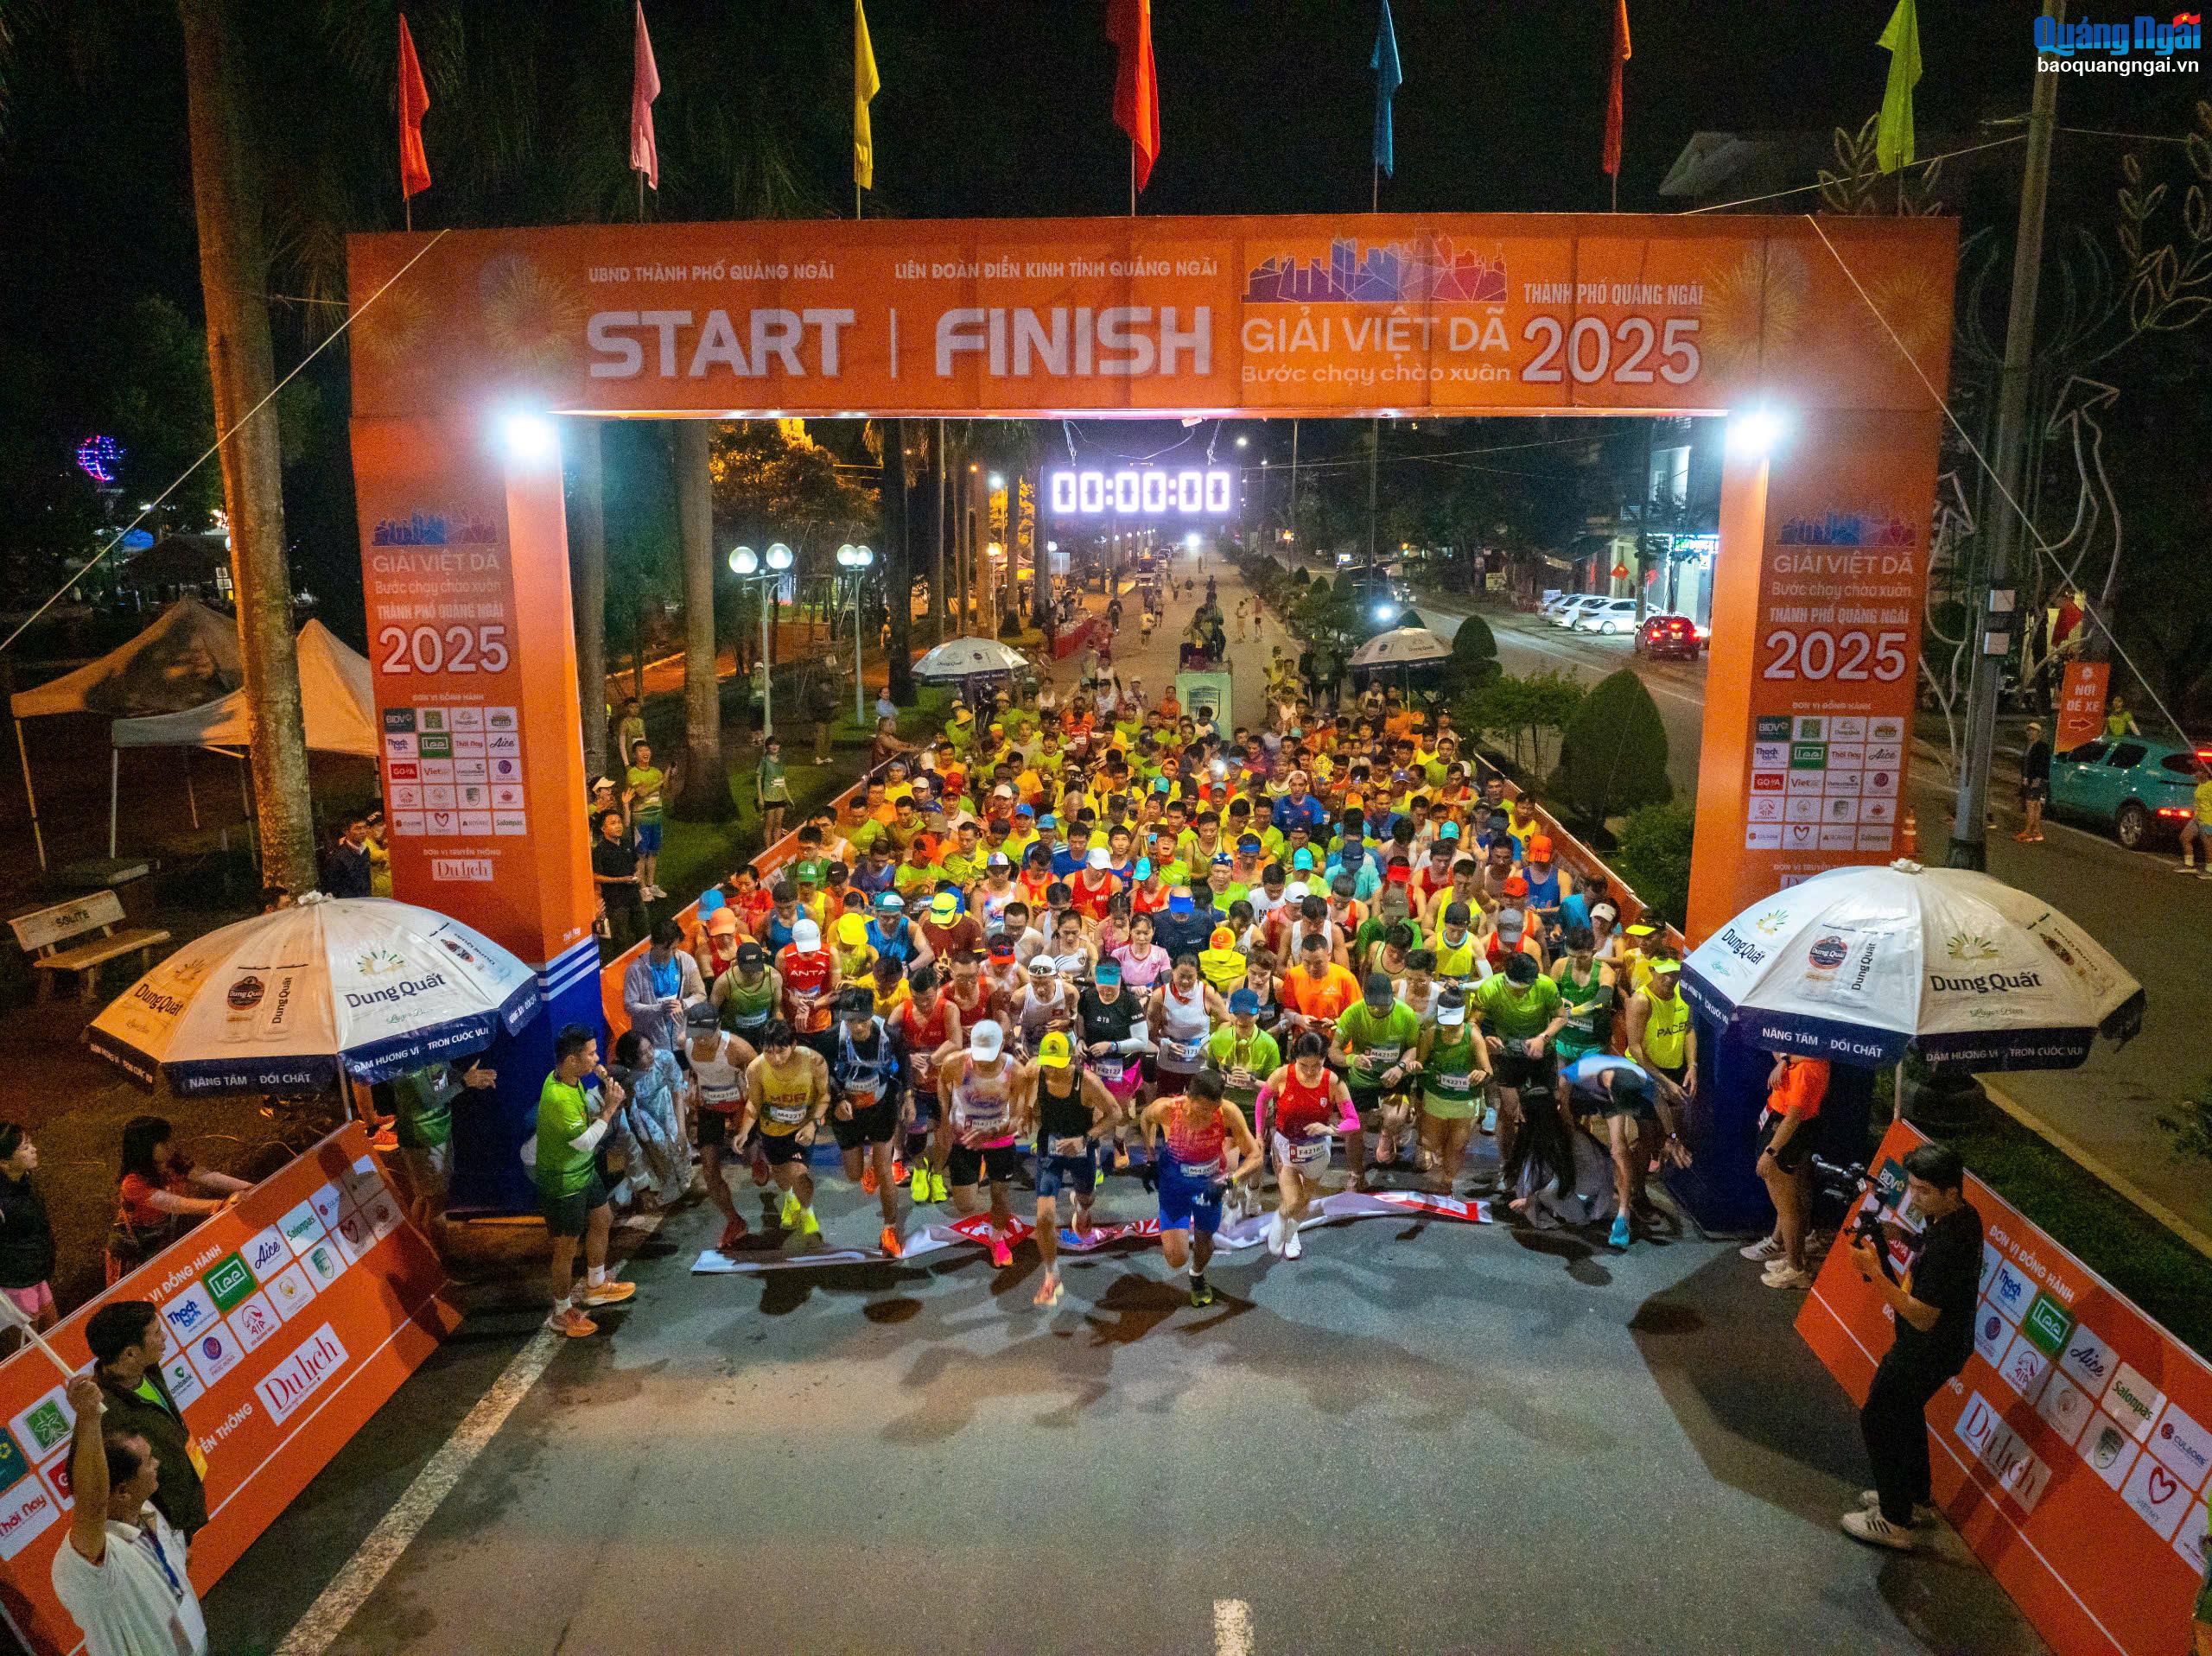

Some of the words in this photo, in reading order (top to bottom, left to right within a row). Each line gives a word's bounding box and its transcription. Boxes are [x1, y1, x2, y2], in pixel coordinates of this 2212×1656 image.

[589, 267, 629, 282] UBND
[635, 262, 687, 282] THÀNH
[692, 257, 724, 281] PHỐ
[730, 259, 788, 281] QUẢNG
[793, 258, 835, 279] NGÃI
[895, 261, 928, 278] LIÊN
[931, 260, 979, 278] ĐOÀN
[984, 259, 1020, 278] ĐIỀN
[1026, 263, 1064, 277] KINH
[1070, 258, 1104, 277] TỈNH
[1109, 257, 1170, 277] QUẢNG
[1176, 257, 1218, 276] NGÃI
[1523, 279, 1573, 305] THÀNH
[1577, 276, 1607, 305] PHỐ
[1611, 277, 1662, 305] QUẢNG
[1667, 281, 1704, 305] NGÃI
[587, 308, 854, 378] START
[934, 306, 1211, 377] FINISH
[1242, 306, 1330, 353] GIẢI
[1342, 306, 1440, 361] VIỆT
[1450, 306, 1510, 353] DÃ
[1521, 315, 1700, 384] 2025
[1242, 364, 1307, 383] Bước
[1312, 364, 1374, 386] chạy
[1380, 364, 1445, 383] chào
[1448, 363, 1511, 383] xuân
[1052, 471, 1230, 513] 00:00:00
[373, 549, 416, 573] GIẢI
[419, 549, 465, 575] VIỆT
[1774, 549, 1823, 574] GIẢI
[1827, 550, 1877, 579] VIỆT
[1881, 551, 1913, 574] DÃ
[1770, 604, 1808, 623] THÀNH
[1838, 604, 1877, 624] QUẢNG
[379, 625, 509, 674] 2025
[1764, 630, 1907, 682] 2025
[1721, 928, 1745, 955] Dung
[1740, 939, 1768, 966] Quất
[790, 968, 826, 977] ANTA
[1852, 965, 1870, 991] Dung
[1861, 942, 1877, 967] Quất
[1930, 974, 1989, 993] Dung
[1987, 971, 2042, 992] Quất
[134, 983, 162, 1009] Dung
[157, 995, 184, 1017] Quất
[277, 977, 293, 1002] Quất
[344, 985, 400, 1009] Dung
[398, 973, 447, 996] Quất
[272, 1000, 287, 1025] Dung
[474, 1027, 489, 1038] VUI
[1762, 1026, 1792, 1042] NÂNG
[189, 1075, 221, 1089] NÂNG
[254, 1240, 282, 1270] Aice
[1989, 1224, 2010, 1248] ĐƠN
[2018, 1249, 2046, 1278] ĐỒNG
[2046, 1272, 2075, 1304] HÀNH
[148, 1287, 165, 1302] VỊ
[162, 1265, 194, 1294] ĐỒNG
[193, 1244, 223, 1271] HÀNH
[214, 1270, 241, 1293] Lee
[263, 1372, 305, 1412] Du
[293, 1336, 340, 1382] lịch
[2070, 1347, 2105, 1379] Aice
[2113, 1381, 2153, 1421] Salonpas
[216, 1402, 254, 1440] THÔNG
[1966, 1401, 1999, 1453] Du
